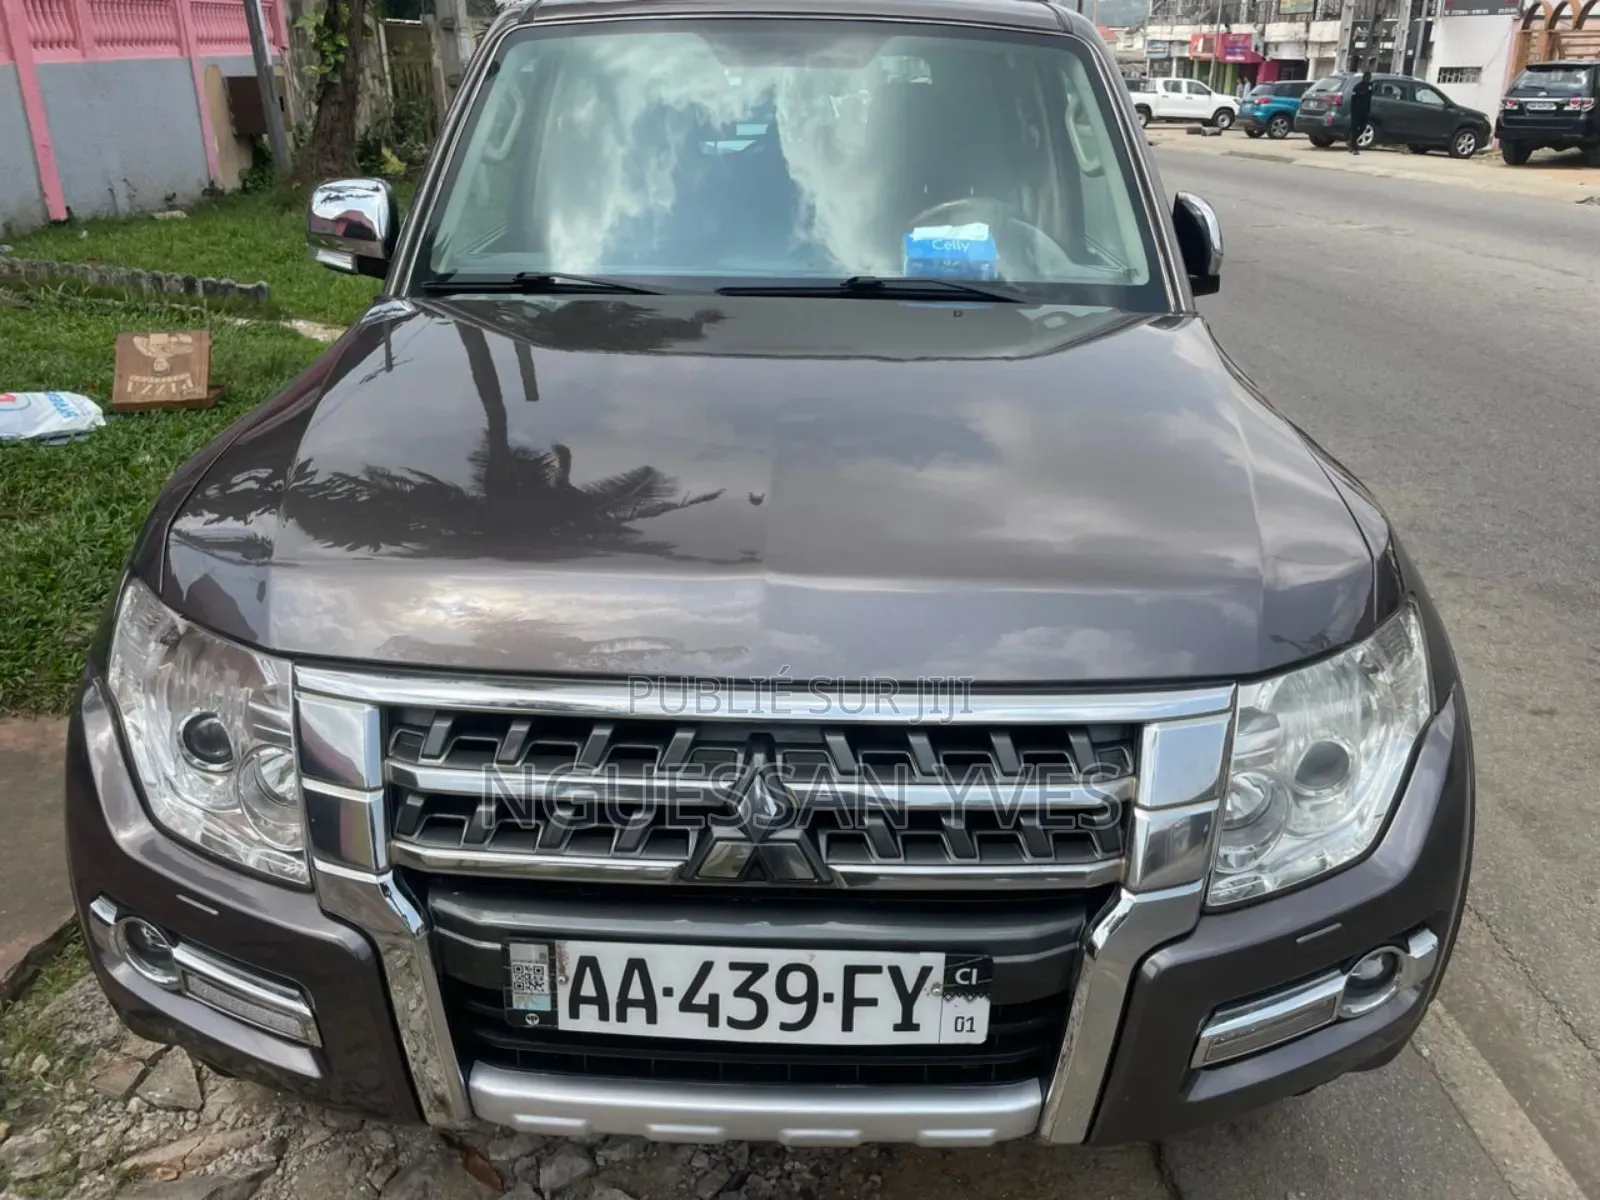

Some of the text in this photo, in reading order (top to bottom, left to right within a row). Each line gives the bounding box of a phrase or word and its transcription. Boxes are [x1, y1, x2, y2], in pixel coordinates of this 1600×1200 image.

[932, 239, 970, 253] Celly
[955, 968, 978, 985] CI
[954, 1016, 976, 1033] 01
